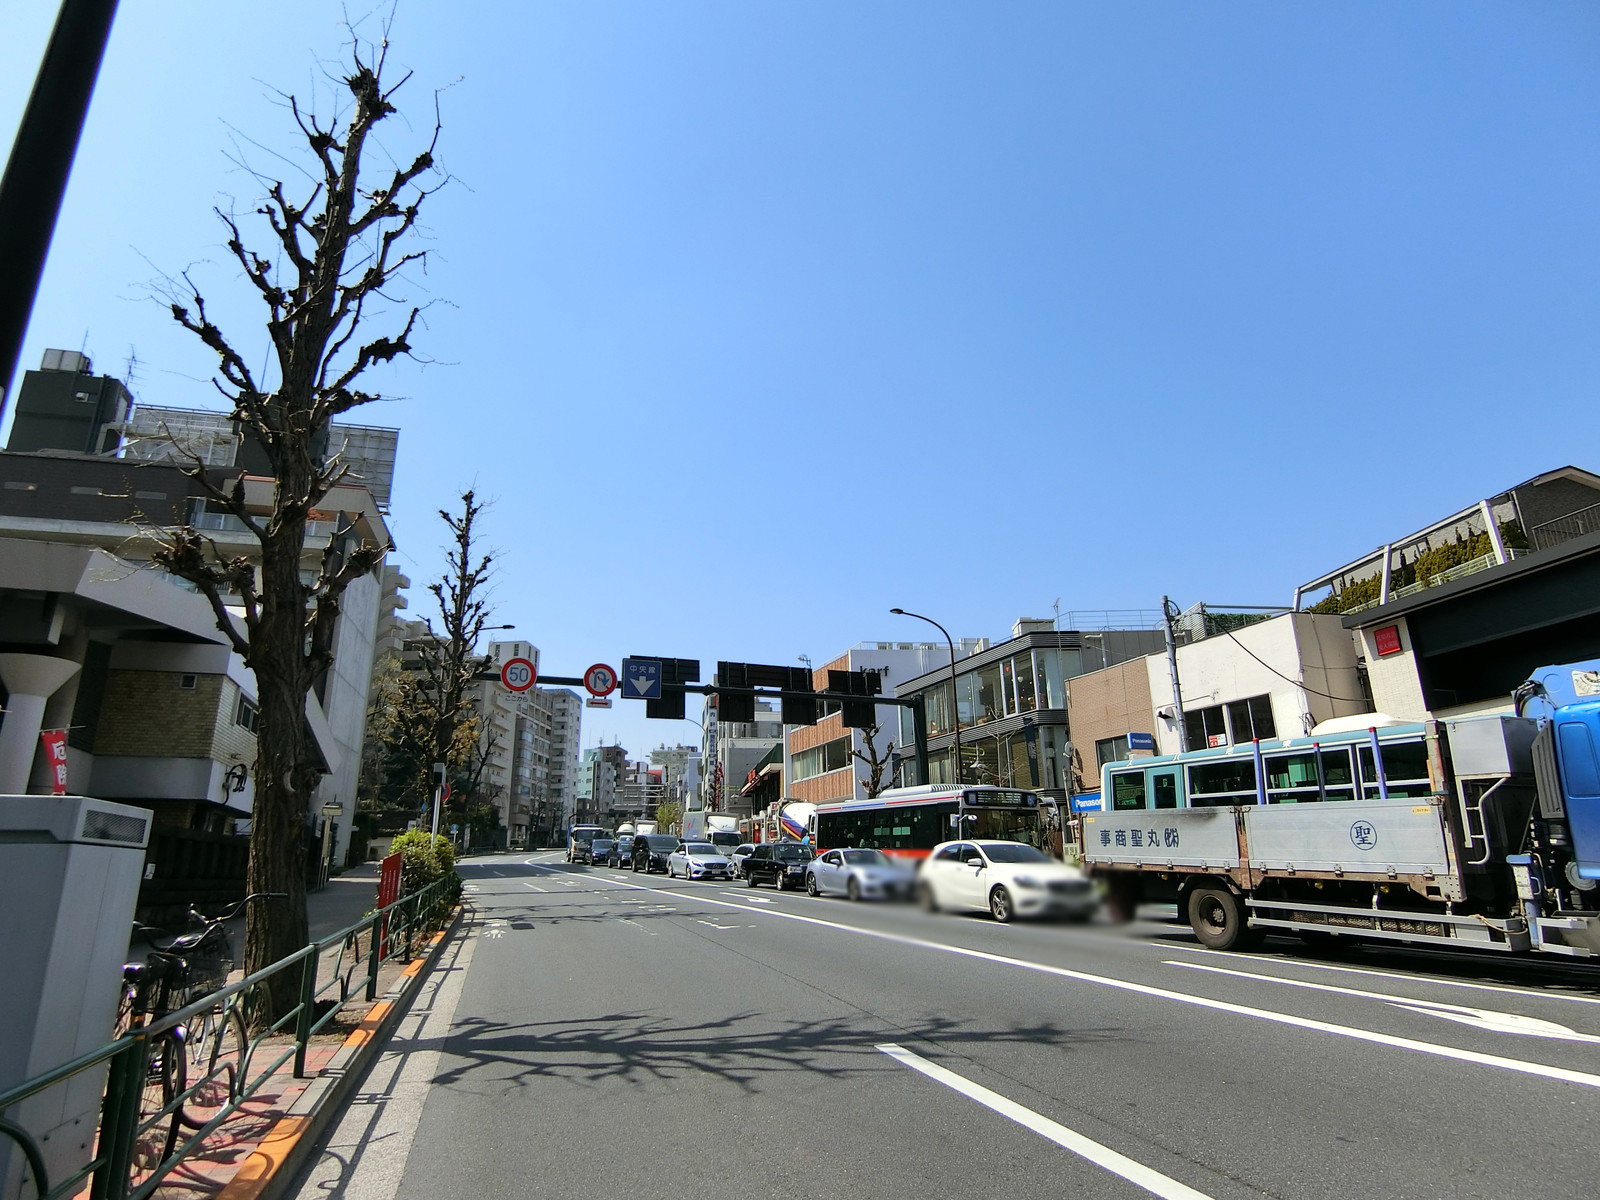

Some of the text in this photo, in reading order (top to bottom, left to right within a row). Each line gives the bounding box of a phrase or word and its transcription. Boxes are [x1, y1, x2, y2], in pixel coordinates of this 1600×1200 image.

[509, 667, 529, 683] 50
[630, 665, 656, 674] 中央線
[505, 695, 529, 703] ここから
[1352, 823, 1374, 847] 聖
